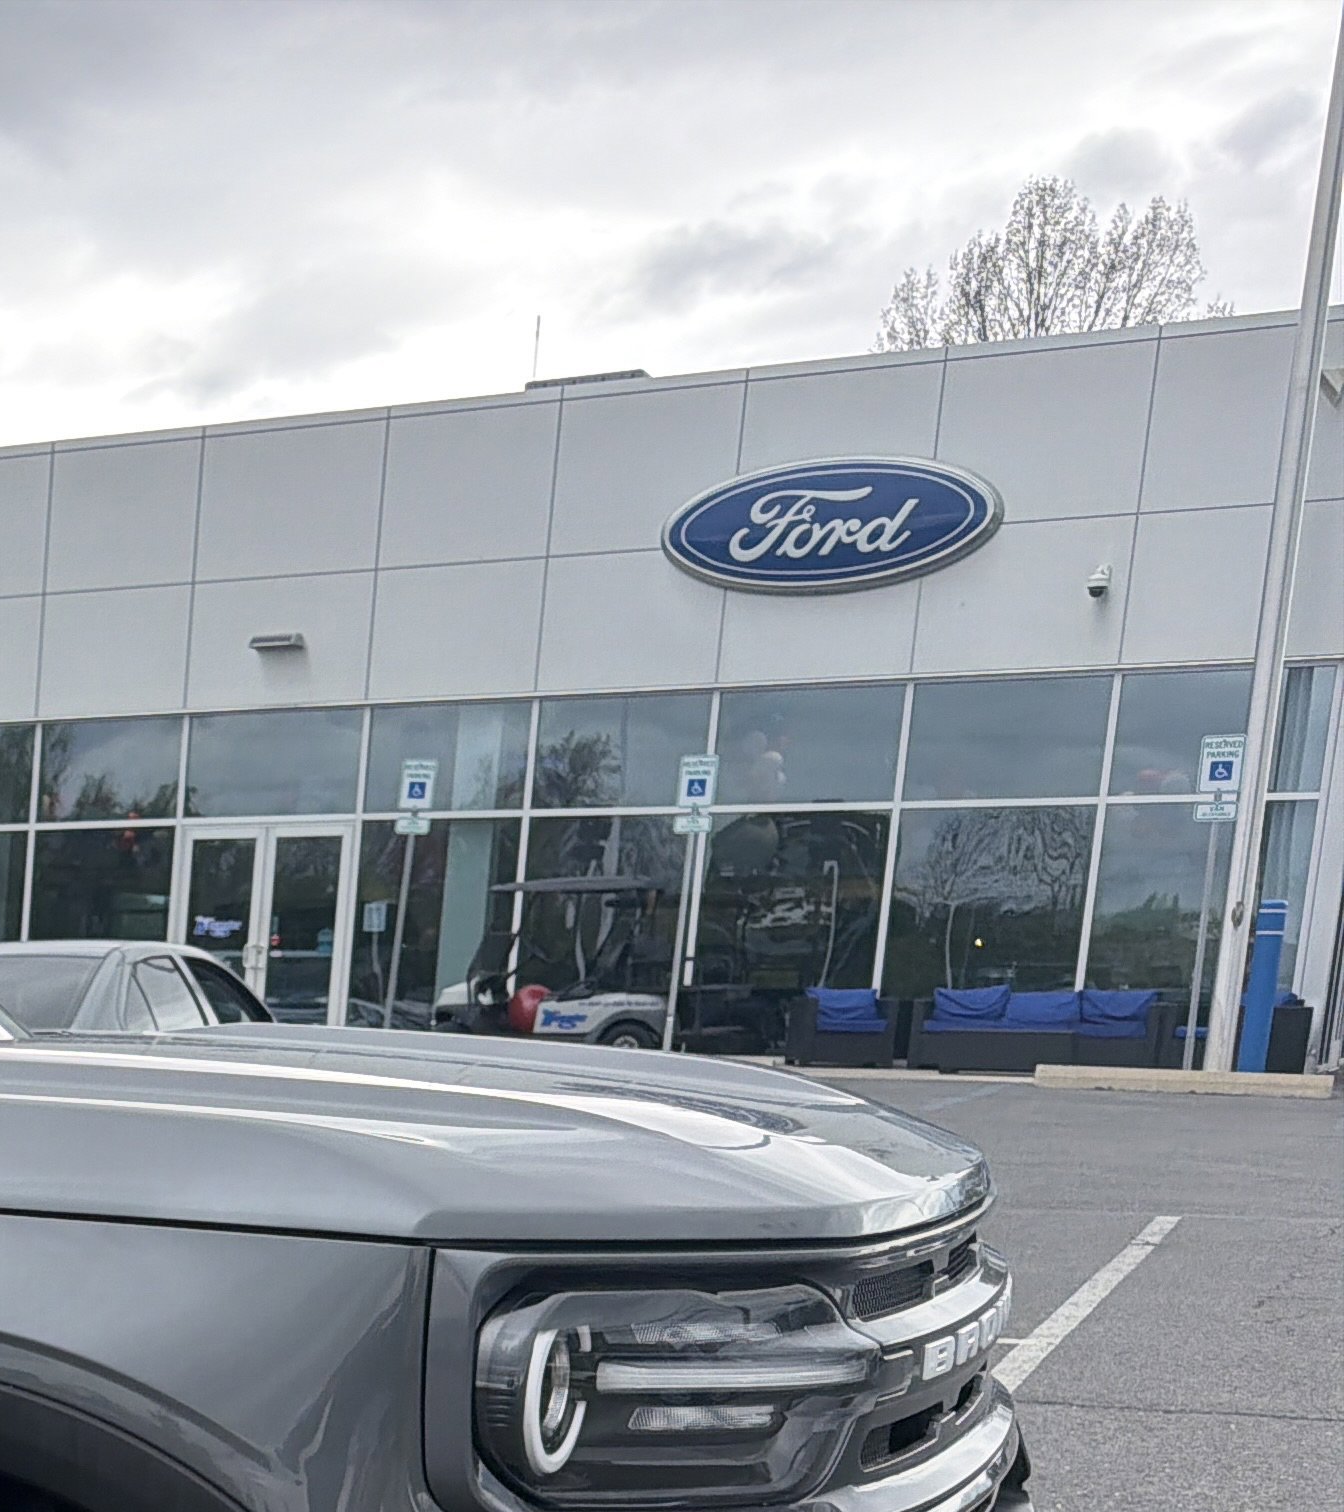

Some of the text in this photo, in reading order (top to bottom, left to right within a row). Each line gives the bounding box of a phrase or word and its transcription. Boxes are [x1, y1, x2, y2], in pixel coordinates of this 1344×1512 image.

[728, 485, 920, 563] Ford
[1204, 741, 1244, 751] RESERVED
[1206, 750, 1240, 759] PARKING
